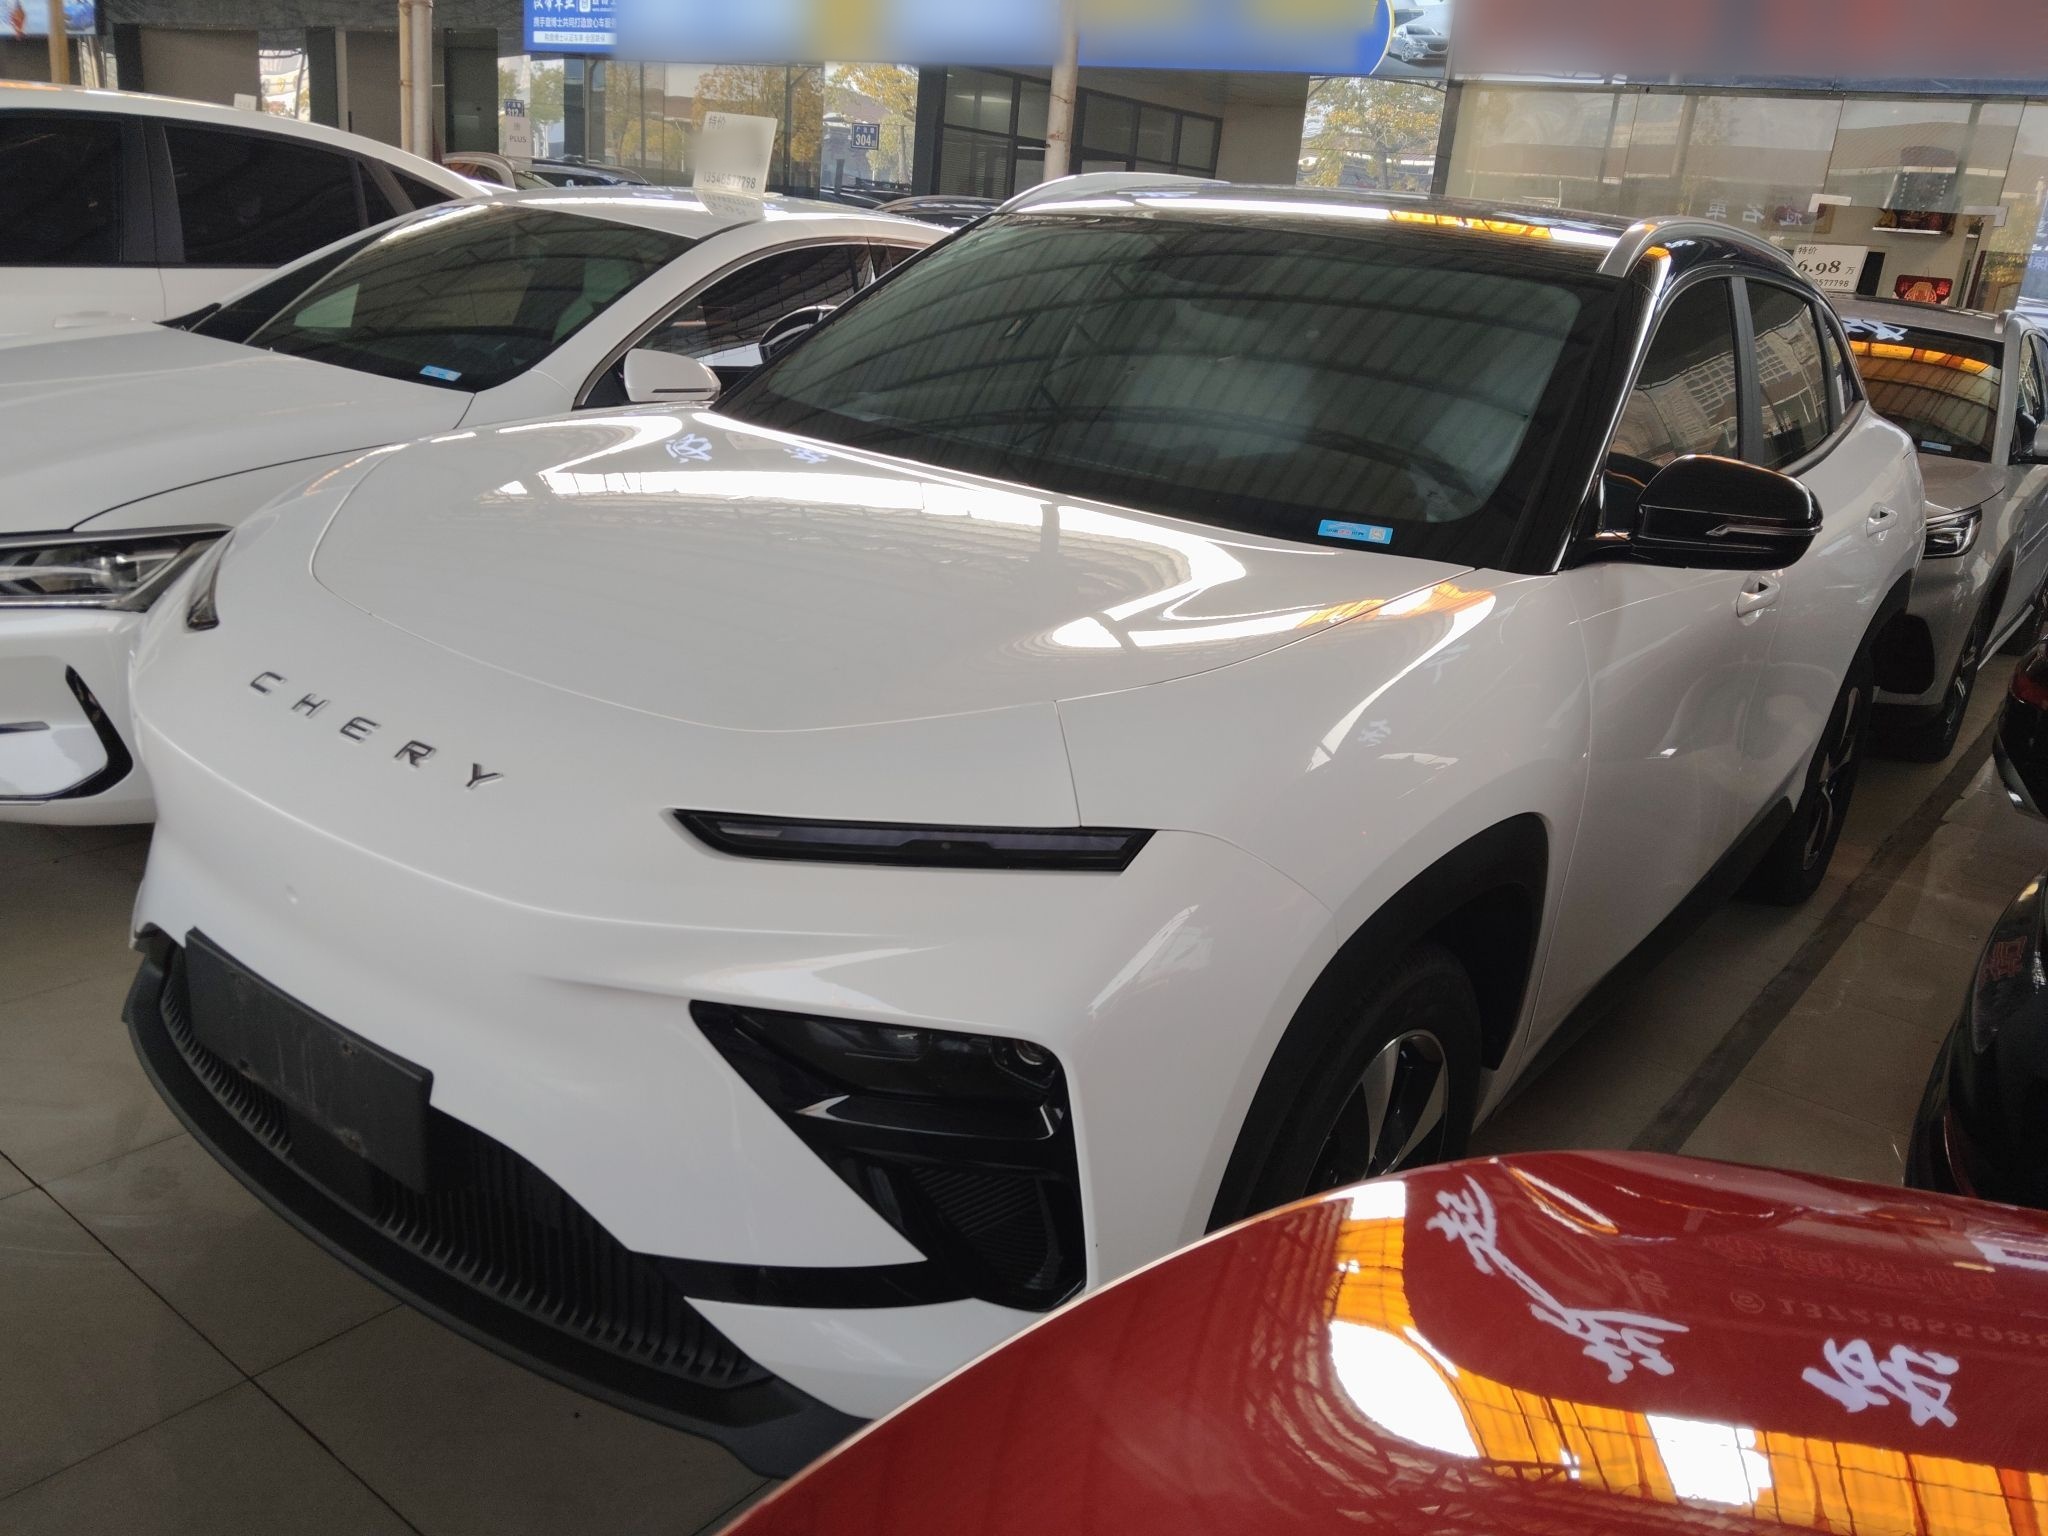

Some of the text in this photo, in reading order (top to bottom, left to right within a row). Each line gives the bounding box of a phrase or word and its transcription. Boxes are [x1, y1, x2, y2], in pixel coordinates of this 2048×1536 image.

[708, 115, 726, 129] 特价
[1797, 246, 1818, 255] 特价
[1797, 259, 1856, 276] 6.98 万
[249, 671, 504, 790] CHERY
